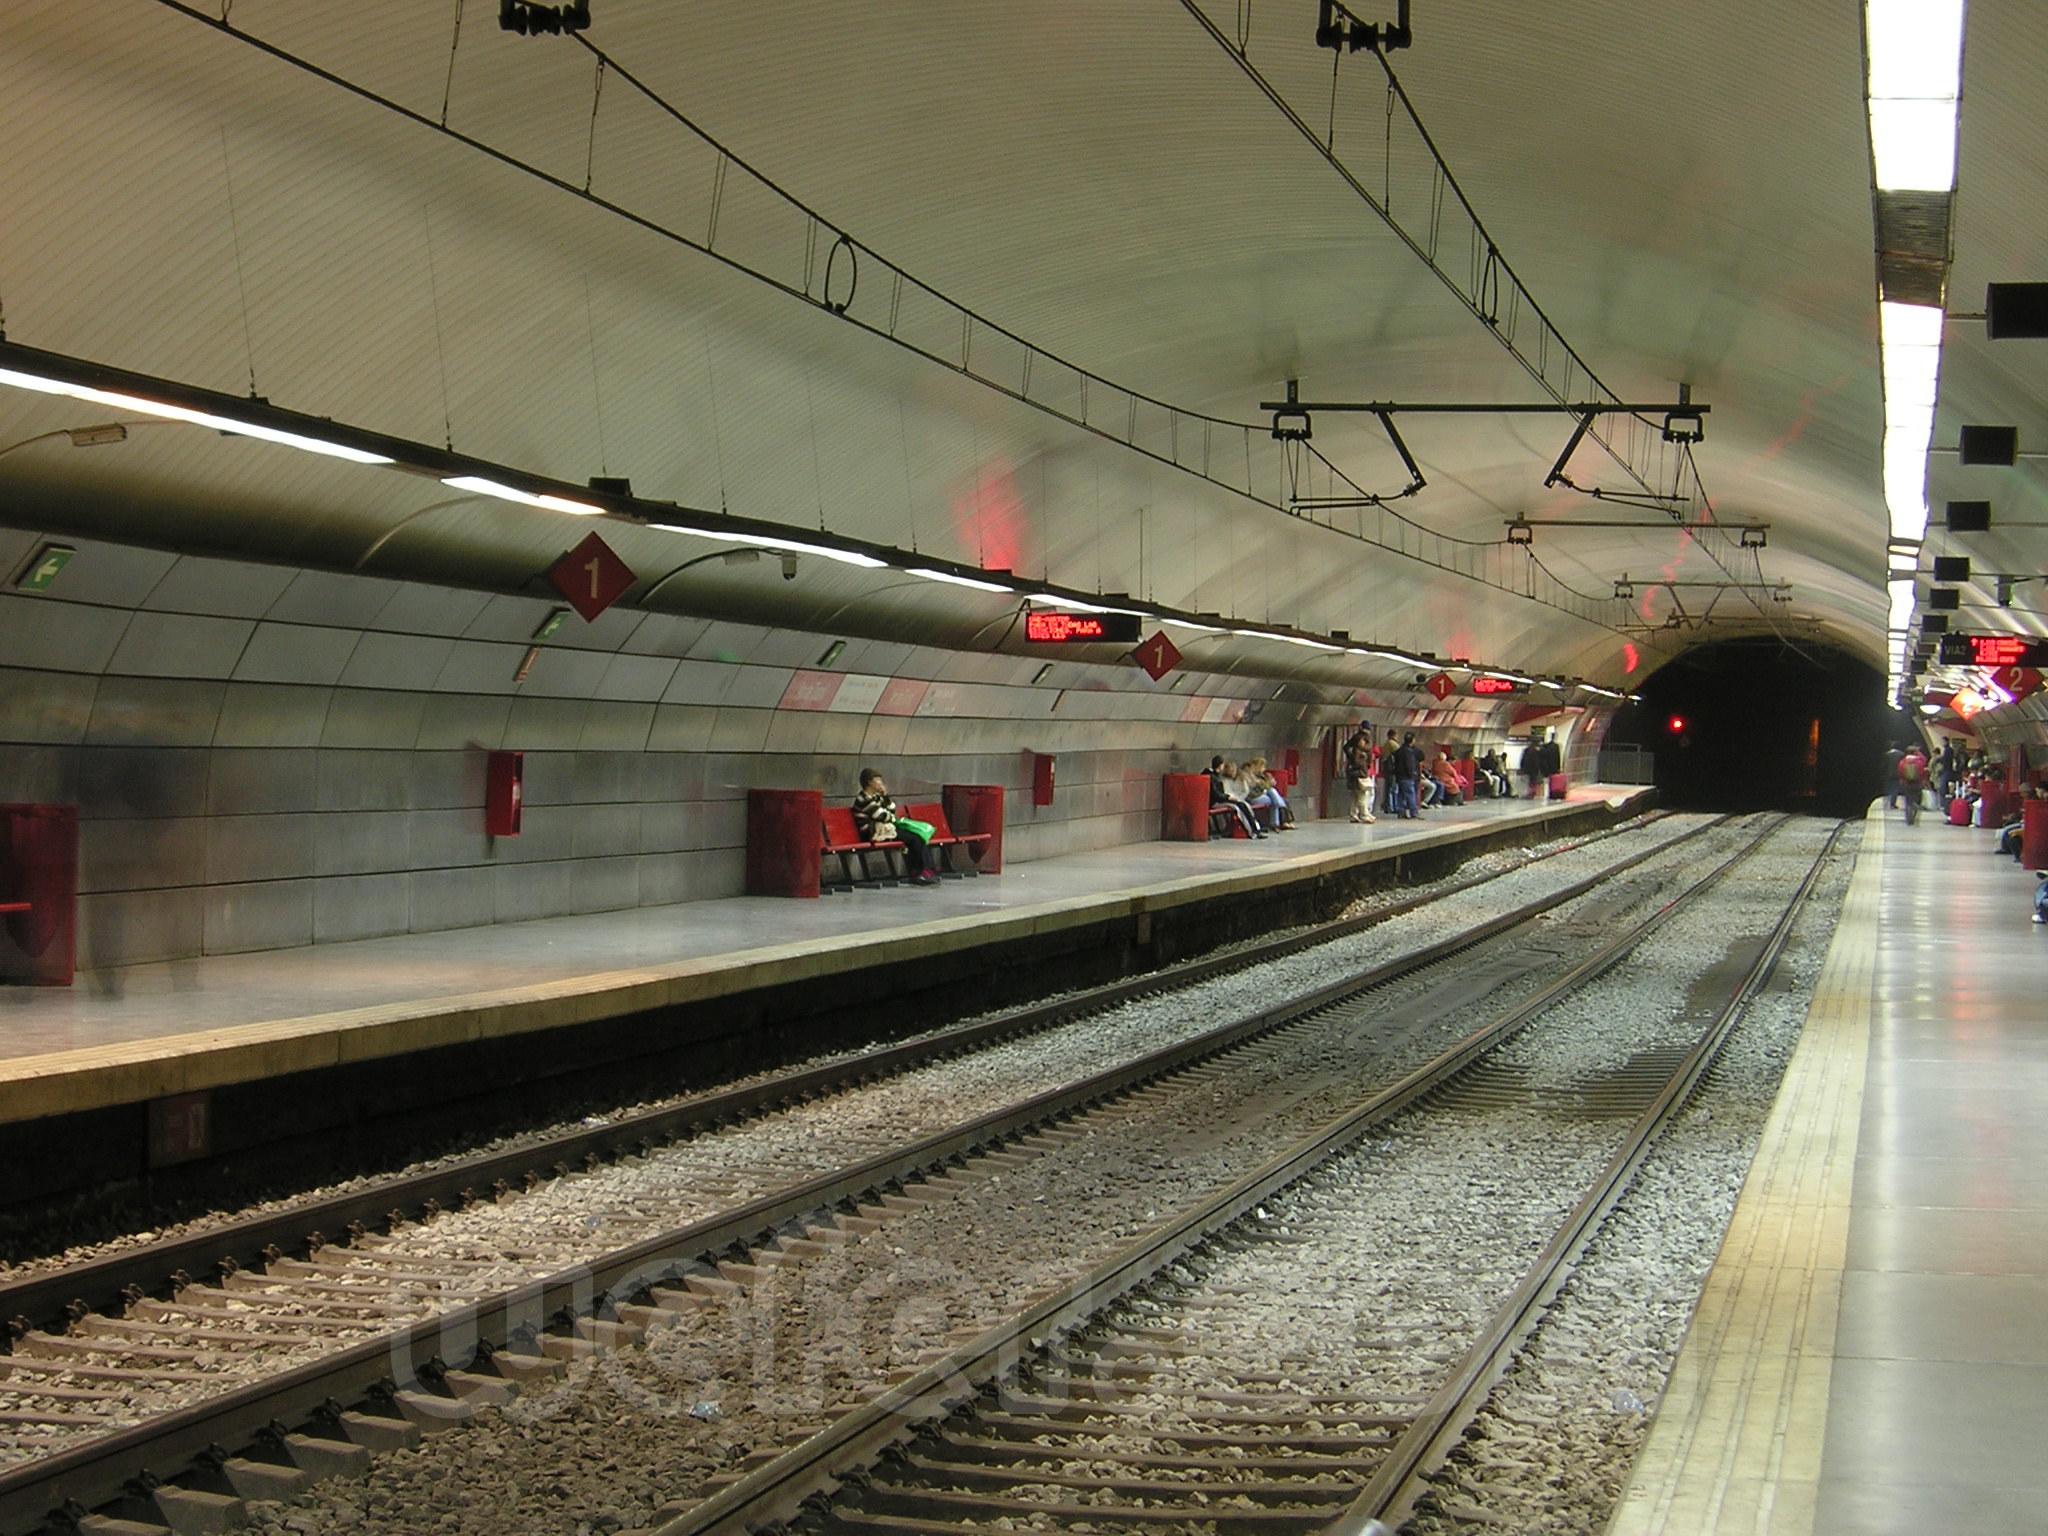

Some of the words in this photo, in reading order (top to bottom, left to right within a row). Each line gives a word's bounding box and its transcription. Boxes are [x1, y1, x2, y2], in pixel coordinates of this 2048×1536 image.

[584, 557, 599, 599] 1
[1154, 644, 1164, 669] 1
[1438, 679, 1446, 695] 1
[2009, 667, 2023, 692] 2
